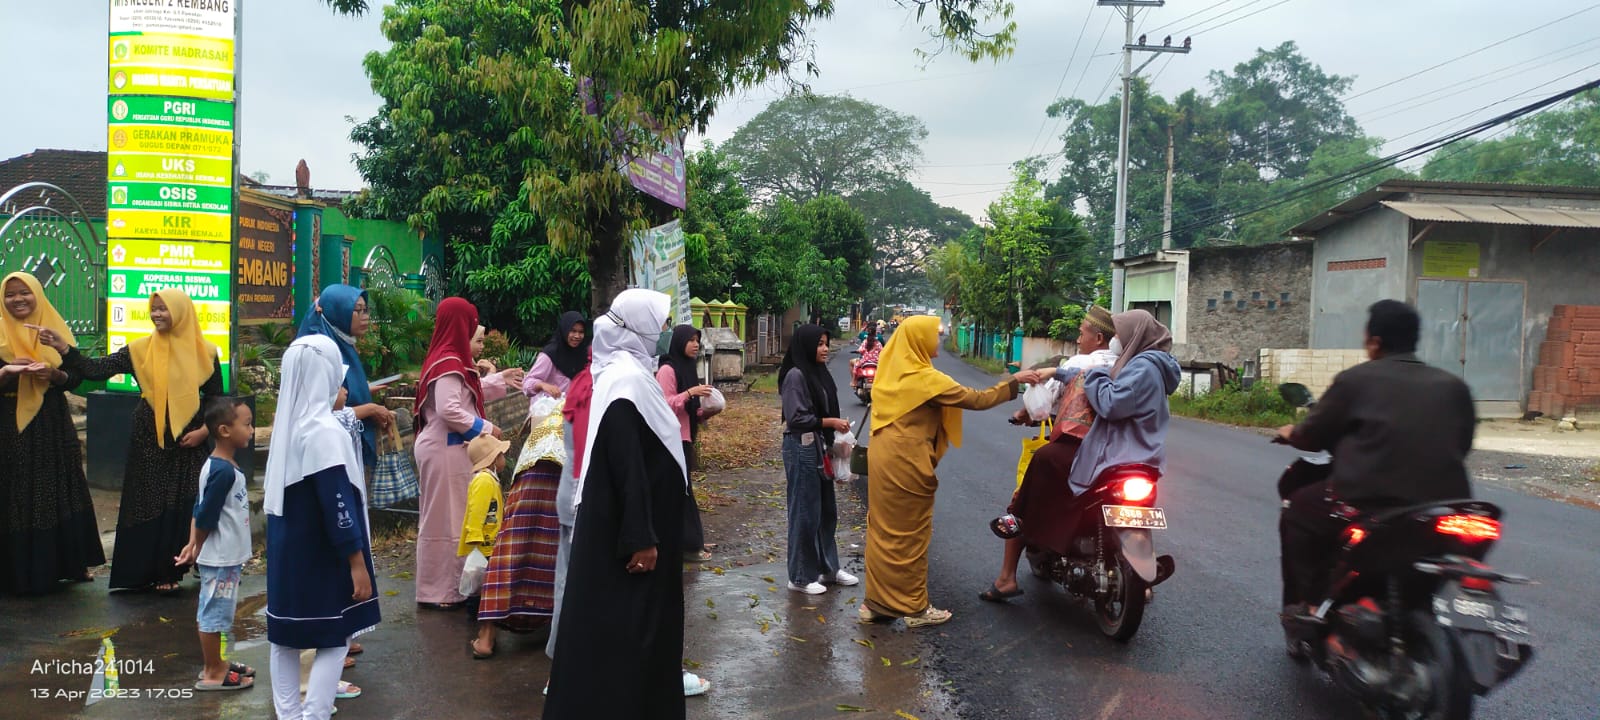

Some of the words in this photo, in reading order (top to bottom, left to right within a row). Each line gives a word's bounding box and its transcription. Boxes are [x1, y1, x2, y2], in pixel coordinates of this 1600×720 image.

[177, 0, 229, 13] REMBANG
[134, 44, 169, 56] KOMITE
[173, 46, 229, 62] MADRASAH
[163, 101, 196, 116] PGRI
[133, 129, 177, 141] GERAKAN
[180, 131, 229, 145] PRAMUKA
[139, 141, 164, 149] GUGUS
[166, 142, 191, 151] DEPAN
[162, 158, 195, 172] UKS
[159, 186, 197, 200] OSIS
[201, 203, 229, 211] SEKOLAH
[163, 215, 191, 229] KIR
[134, 227, 159, 235] KARYA
[161, 228, 188, 237] ILMIAH
[190, 230, 224, 239] REMAJA
[160, 244, 195, 258] PMR
[257, 239, 275, 253] NEGERI
[143, 273, 183, 283] KOPERASI
[185, 274, 211, 283] SISWA
[239, 258, 288, 287] EMBANG
[207, 311, 226, 324] OSIS
[1105, 507, 1113, 517] K
[1148, 510, 1163, 520] TM
